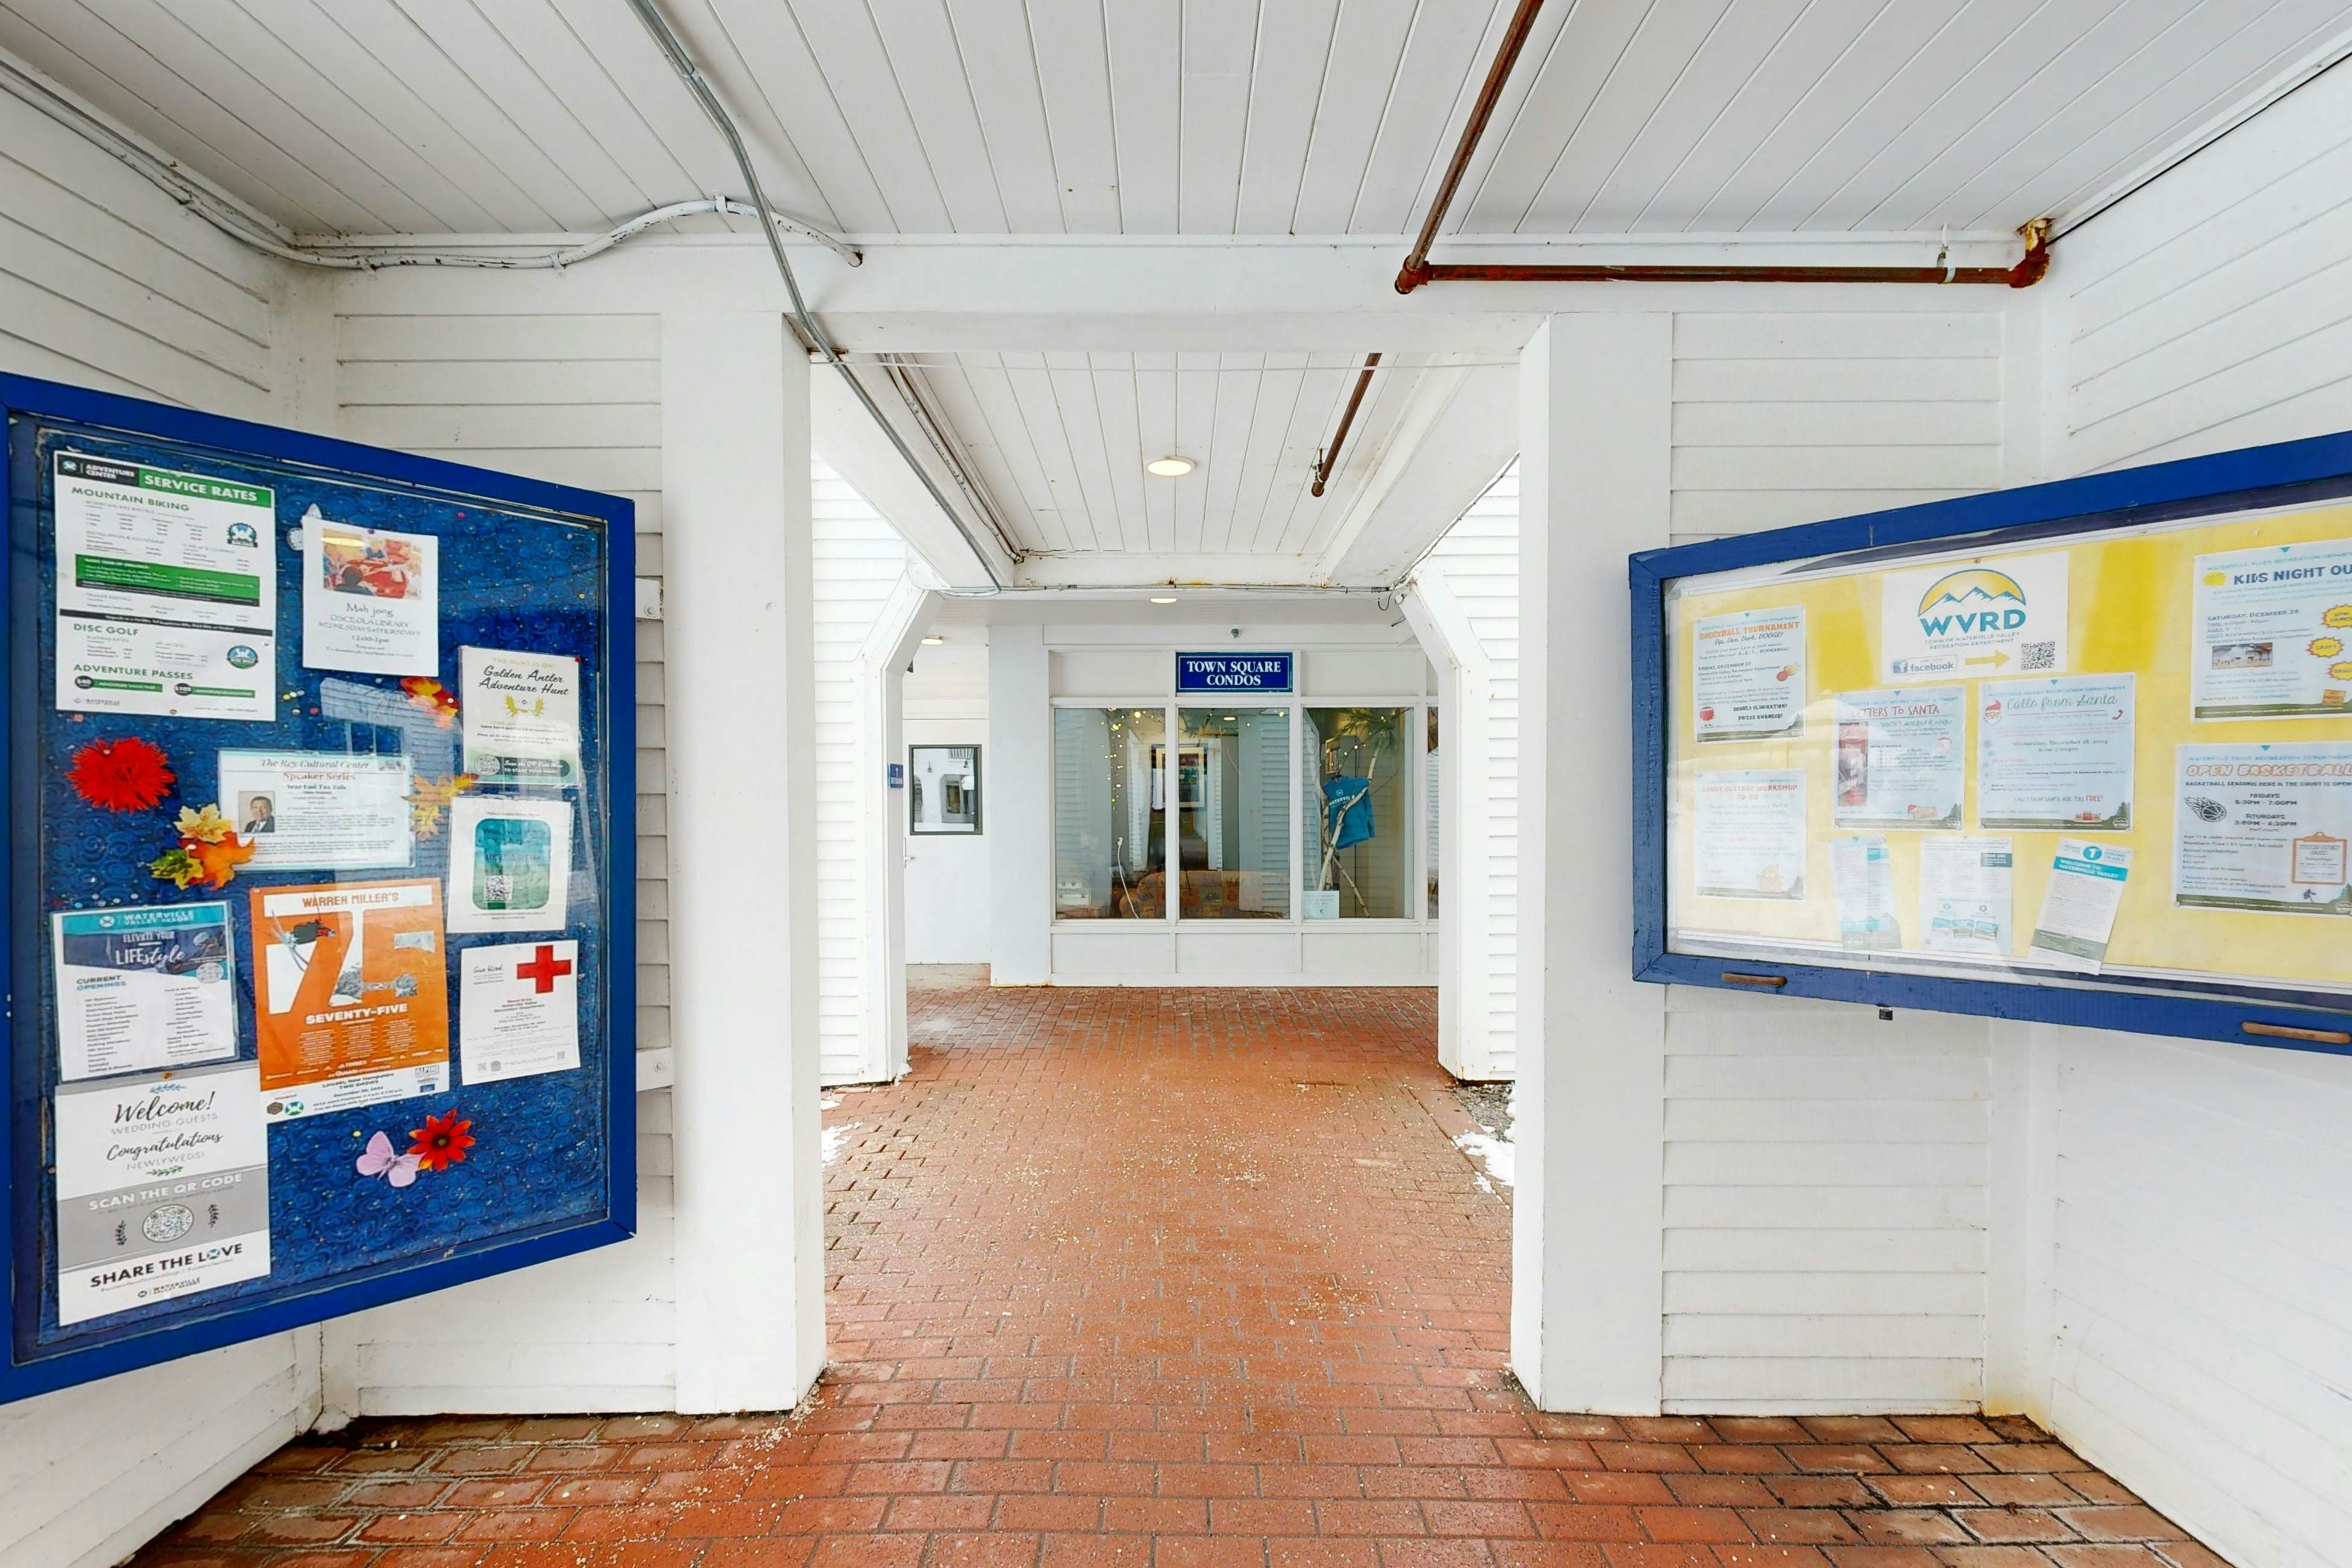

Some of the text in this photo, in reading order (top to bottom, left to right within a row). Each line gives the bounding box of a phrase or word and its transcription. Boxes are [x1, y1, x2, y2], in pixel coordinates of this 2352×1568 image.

[86, 463, 135, 478] ADVENTURE
[86, 469, 117, 480] CENTER
[144, 474, 258, 502] SERVICE RATES
[72, 486, 144, 505] MOUNTAIN
[148, 498, 190, 511] BIKING
[2233, 572, 2269, 585] KIDS
[2273, 567, 2326, 581] NIGHT
[346, 602, 369, 613] Mah
[73, 623, 139, 636] DISC GOLF
[1743, 621, 1800, 633] TOURNAMENT
[1920, 609, 2026, 637] WVRD
[1971, 638, 2014, 647] DEPARTMENT
[73, 664, 193, 680] ADVENTURE PASSES
[484, 665, 564, 683] Golden Antler
[1187, 661, 1281, 675] TOWN SQUARE
[1911, 662, 1953, 672] facebook
[479, 677, 569, 695] Adventure Hunt
[1207, 674, 1261, 685] CONDOS
[2007, 694, 2118, 711] Calls from Santa
[1852, 706, 1888, 717] LETTERS
[1908, 704, 1940, 715] SANTA
[300, 759, 338, 768] Cultural
[2186, 763, 2352, 777] OPEN BASKETBALL
[284, 772, 323, 780] Speaker
[302, 892, 400, 907] WARREN MILLER'S
[124, 910, 194, 921] WATERVILLE
[123, 932, 175, 942] ELEVATE YOUR
[76, 975, 122, 985] CURRENT
[77, 981, 126, 991] OPENINGS
[305, 1003, 408, 1025] SEVENTY-FIVE
[114, 1091, 216, 1124] Welcome!
[111, 1113, 219, 1135] WEDDING GUESTS
[107, 1131, 223, 1162] Congratulations
[89, 1193, 135, 1210] SCAN
[139, 1187, 169, 1199] THE
[174, 1182, 197, 1194] QR
[201, 1174, 243, 1189] CODE
[90, 1263, 154, 1288] SHARE
[159, 1254, 193, 1271] THE
[198, 1243, 243, 1263] LOVE
